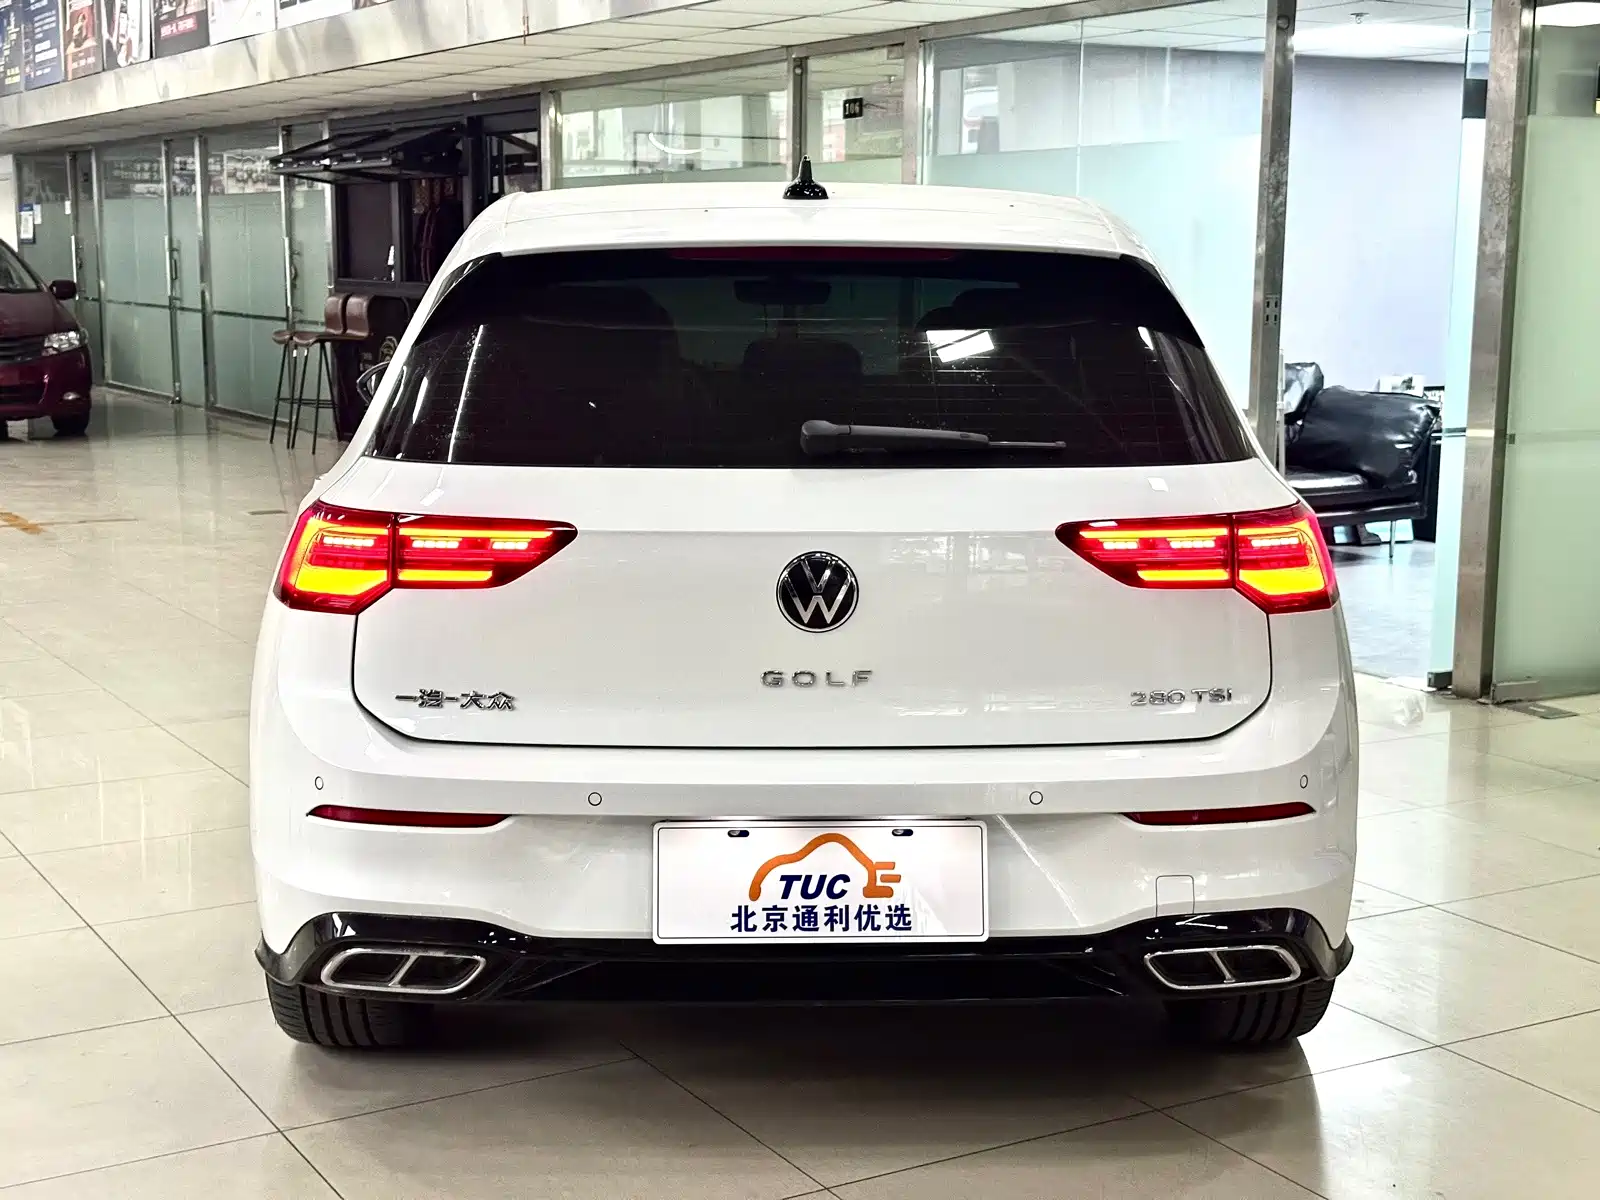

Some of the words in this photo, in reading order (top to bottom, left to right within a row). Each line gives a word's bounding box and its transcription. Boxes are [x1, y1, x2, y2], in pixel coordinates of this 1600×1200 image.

[780, 555, 854, 627] VW
[761, 669, 872, 688] GOLF
[1131, 690, 1186, 706] 280
[779, 874, 851, 900] TUC
[730, 904, 912, 933] 北京通利优选
